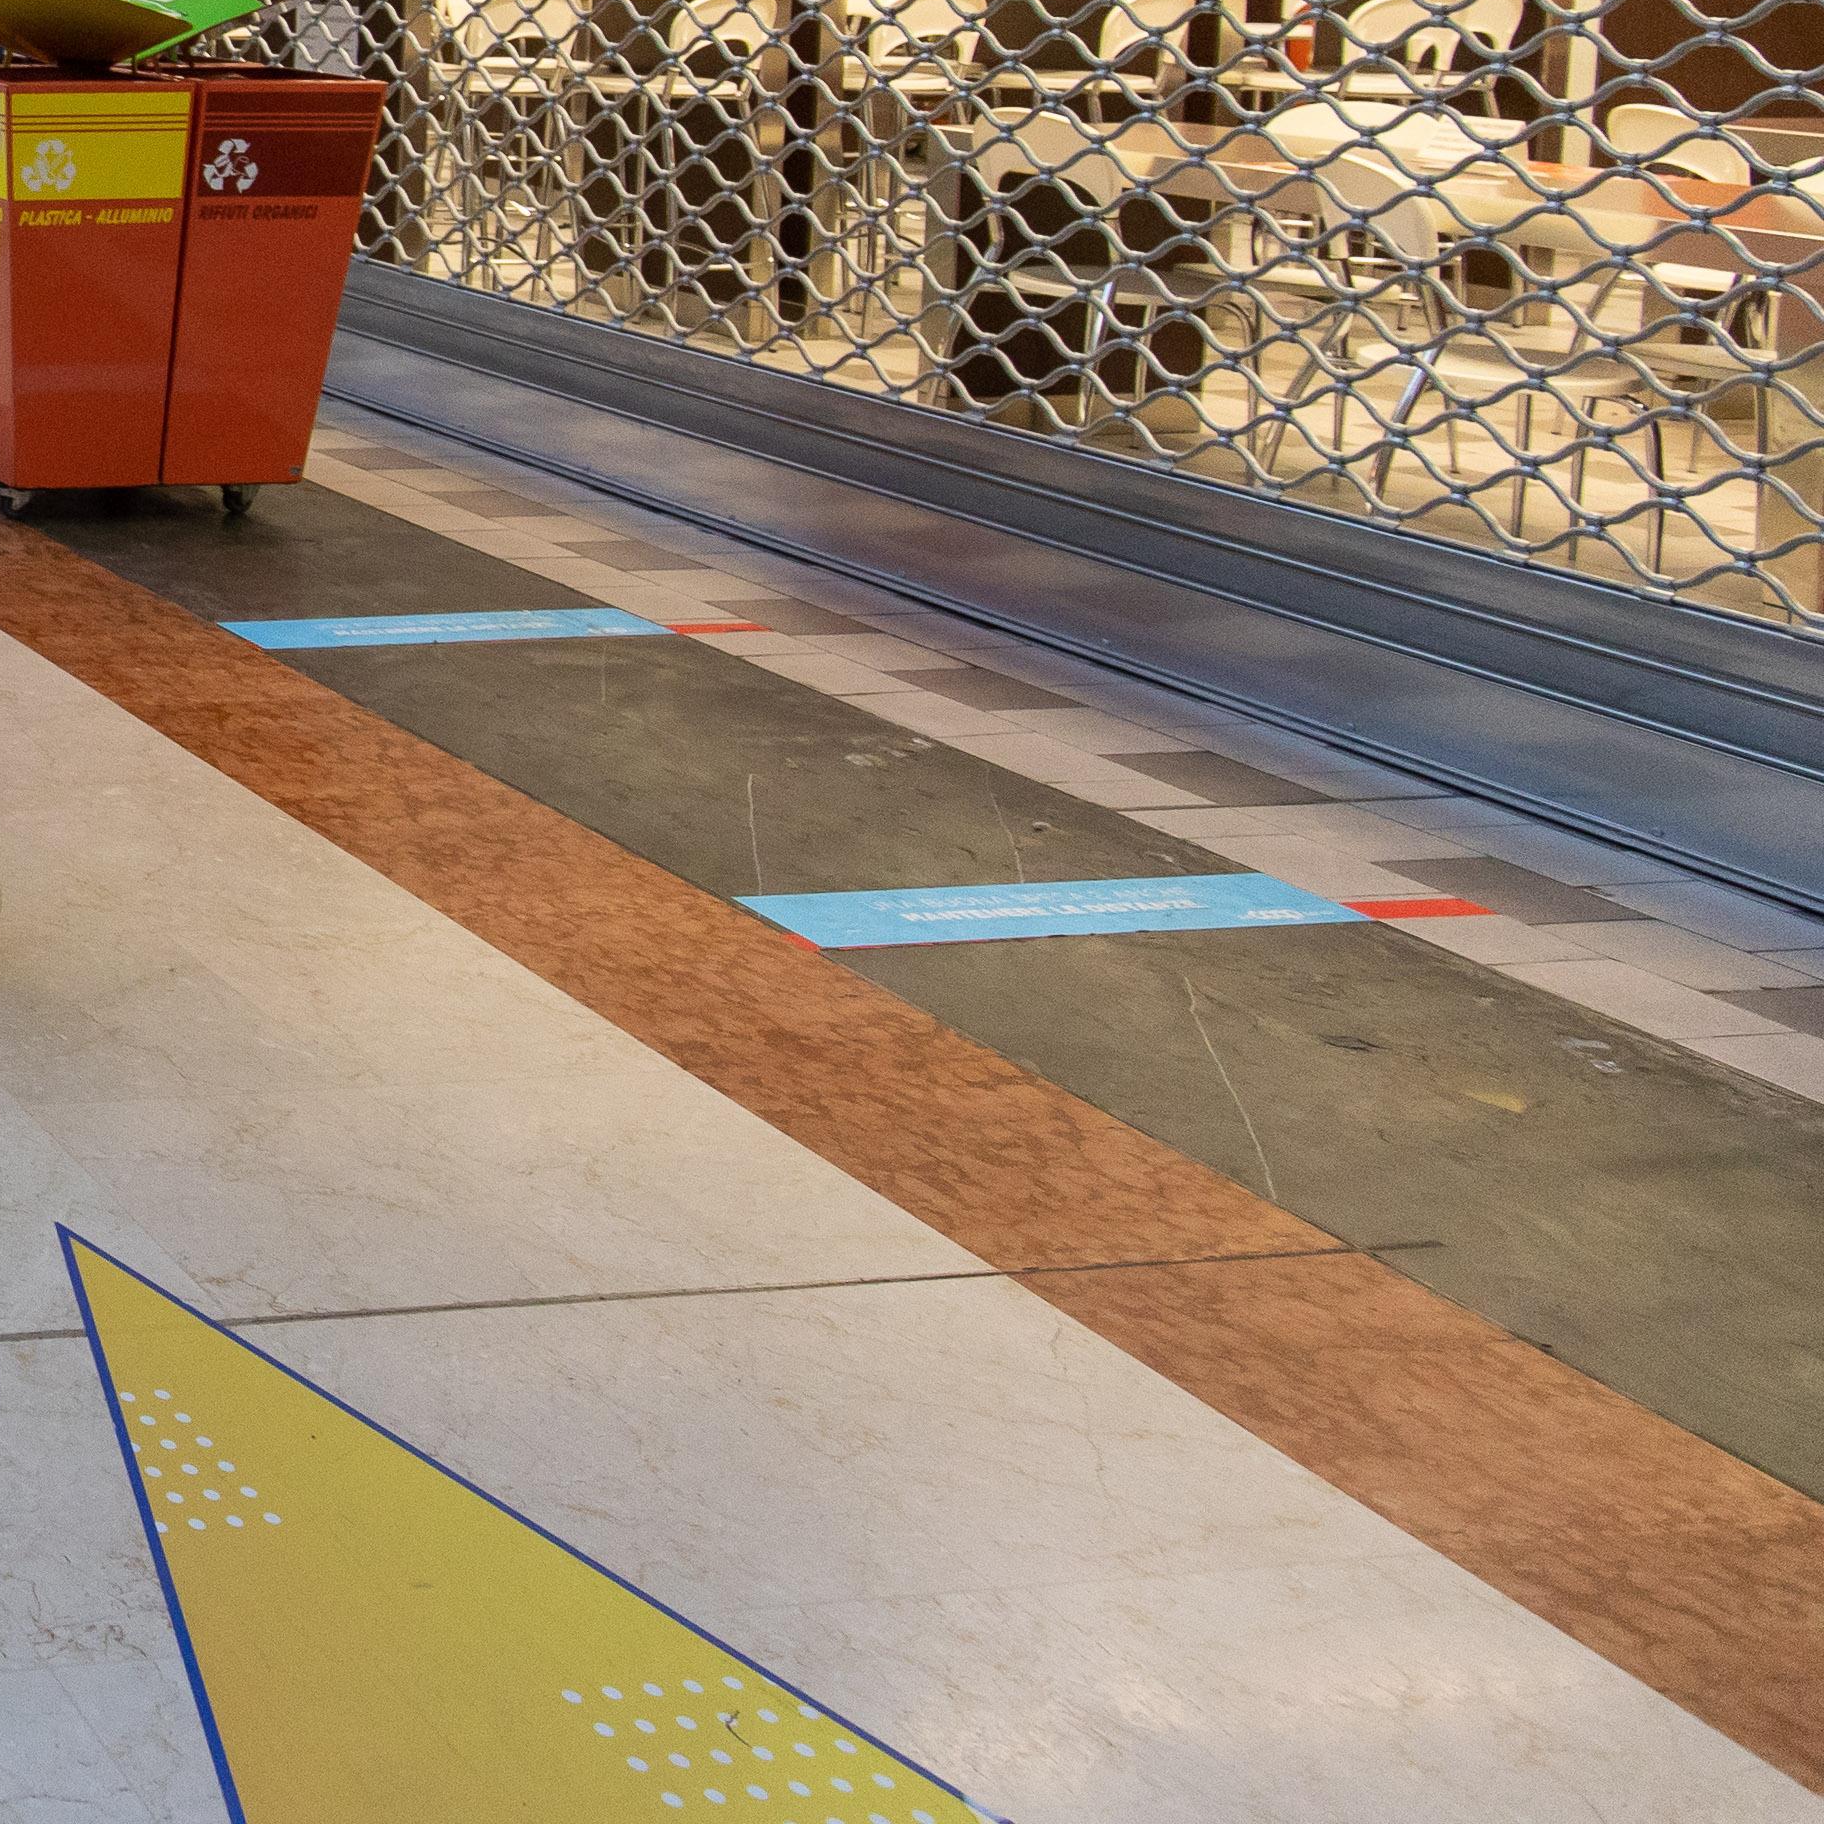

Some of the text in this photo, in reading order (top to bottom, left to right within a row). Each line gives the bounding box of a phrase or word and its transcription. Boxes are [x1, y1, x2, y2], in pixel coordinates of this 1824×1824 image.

[19, 210, 83, 226] PLASTICA
[96, 207, 175, 224] ALLUMINIO
[252, 204, 319, 219] ORGANICI
[899, 906, 1051, 922] MANTENERE
